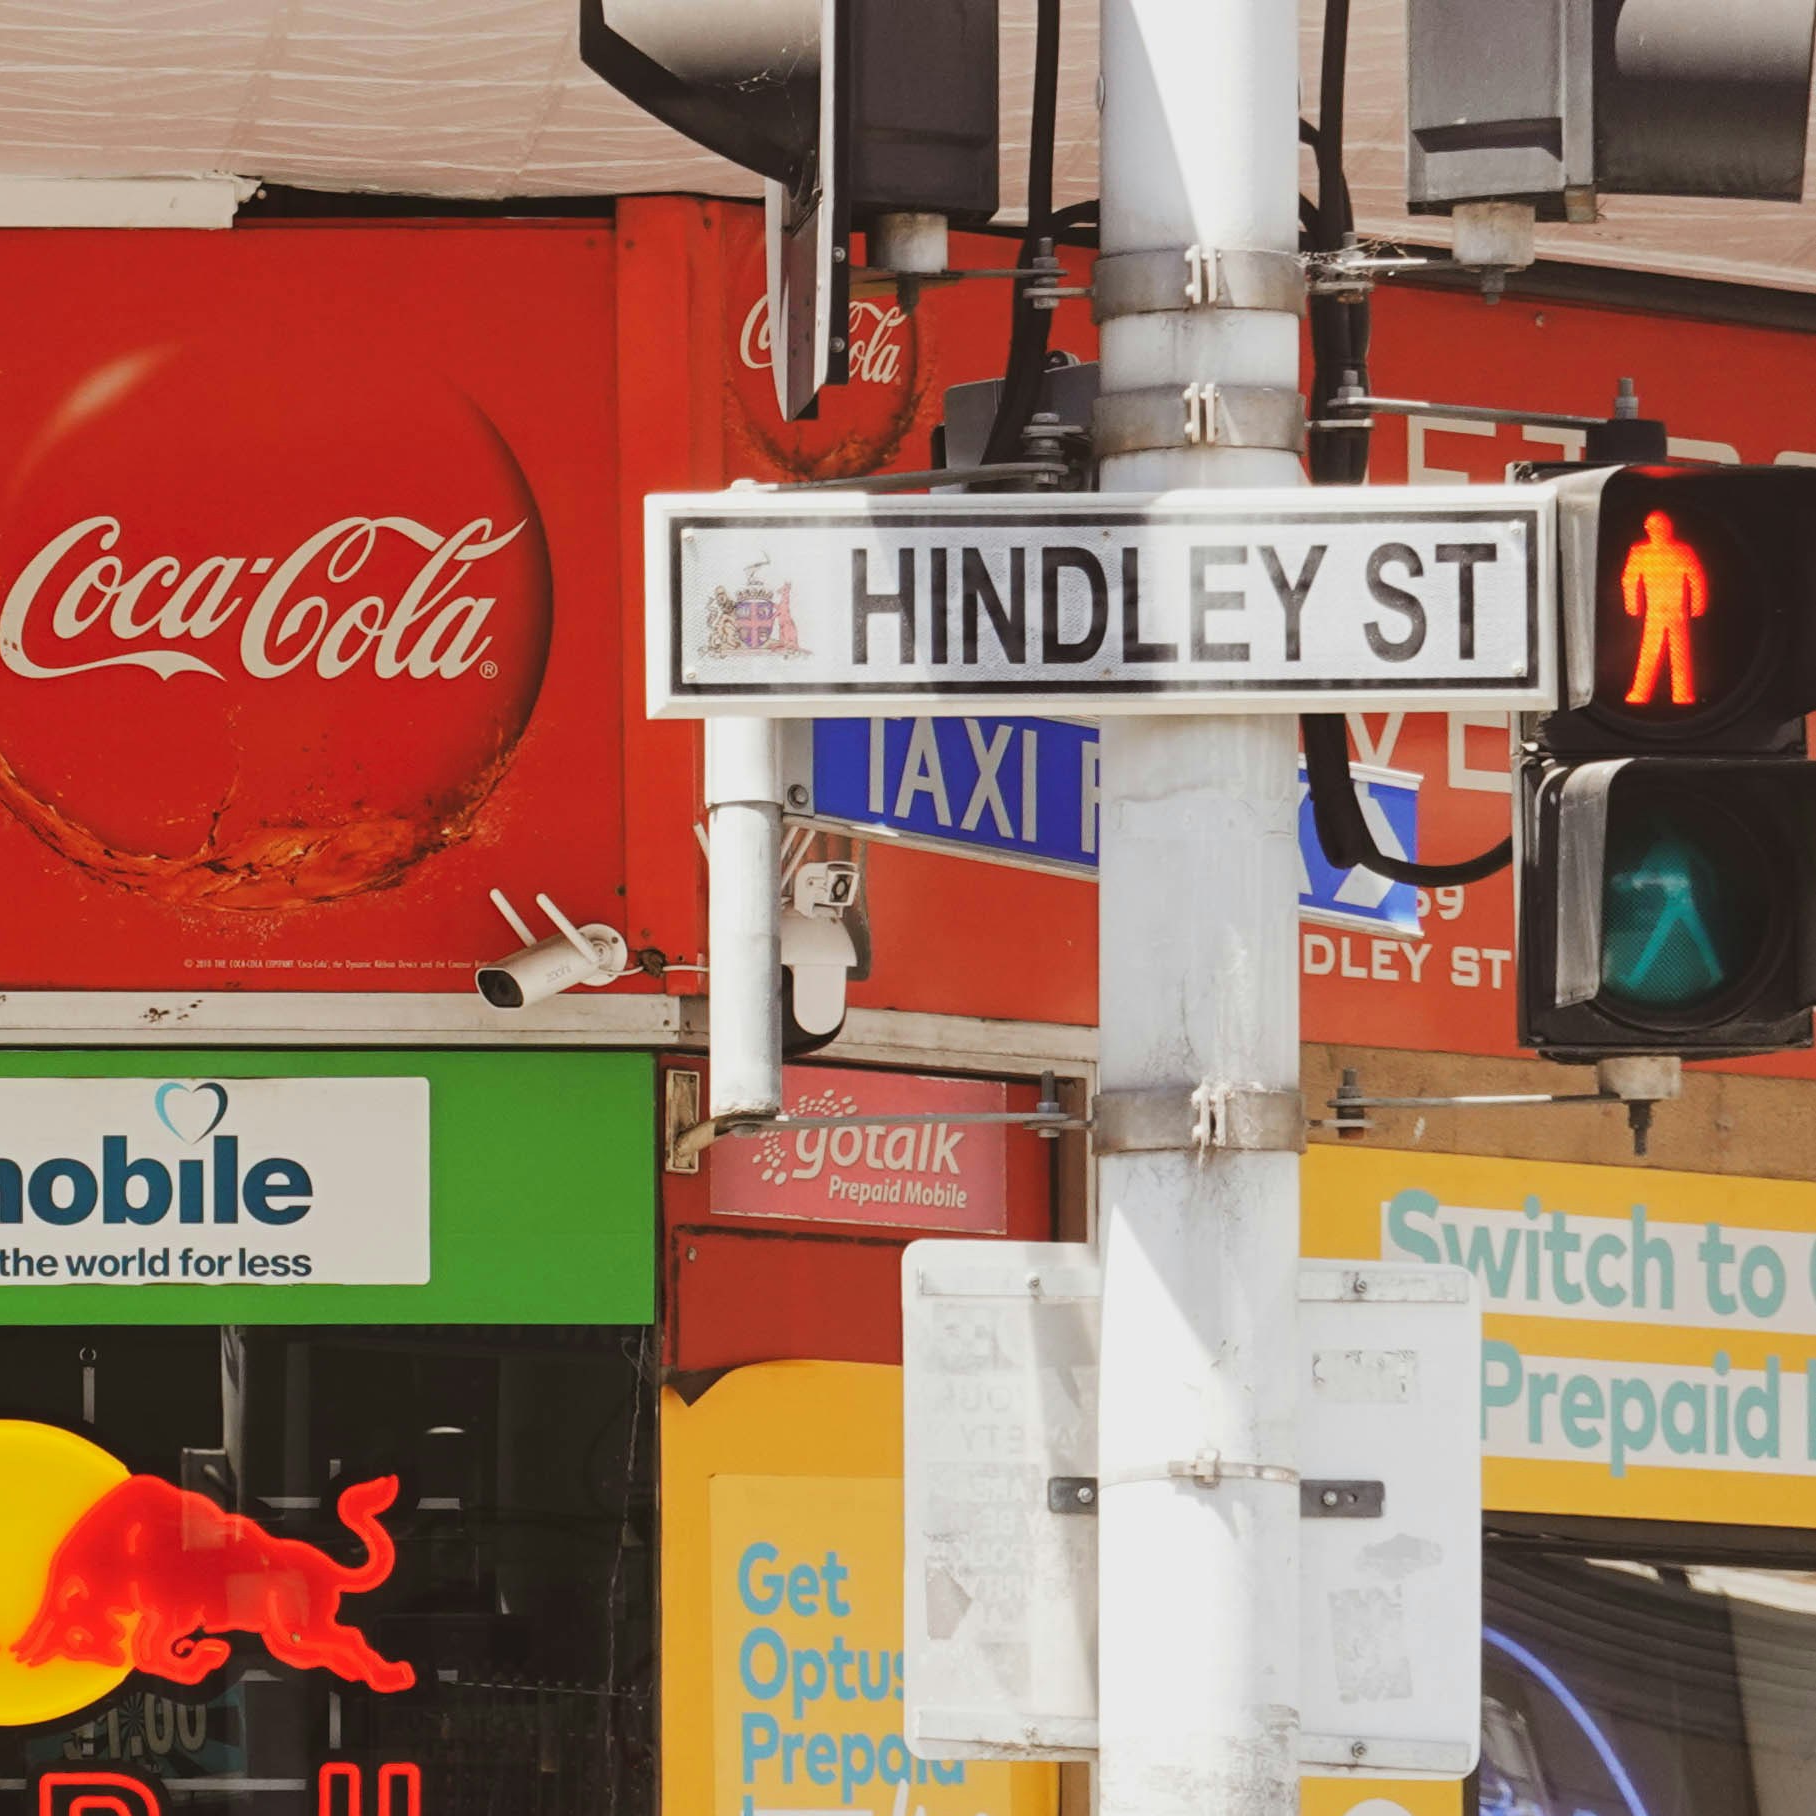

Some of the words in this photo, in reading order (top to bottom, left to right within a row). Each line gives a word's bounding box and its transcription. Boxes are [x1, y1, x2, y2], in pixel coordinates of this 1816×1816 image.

[848, 543, 1328, 665] HINDLEY
[1362, 542, 1498, 662] ST
[868, 716, 1039, 842] TAXI
[1302, 933, 1433, 984] DLEY
[1450, 946, 1512, 989] ST
[792, 1120, 965, 1180] gotalk
[828, 1174, 900, 1207] Prepaid
[904, 1178, 968, 1209] Mobile
[64, 1246, 170, 1279] world
[178, 1246, 234, 1279] for
[238, 1246, 313, 1279] less
[1388, 1187, 1675, 1312] Switch
[1699, 1222, 1787, 1318] to
[1481, 1339, 1781, 1478] Prepaid
[738, 1541, 852, 1618] Get
